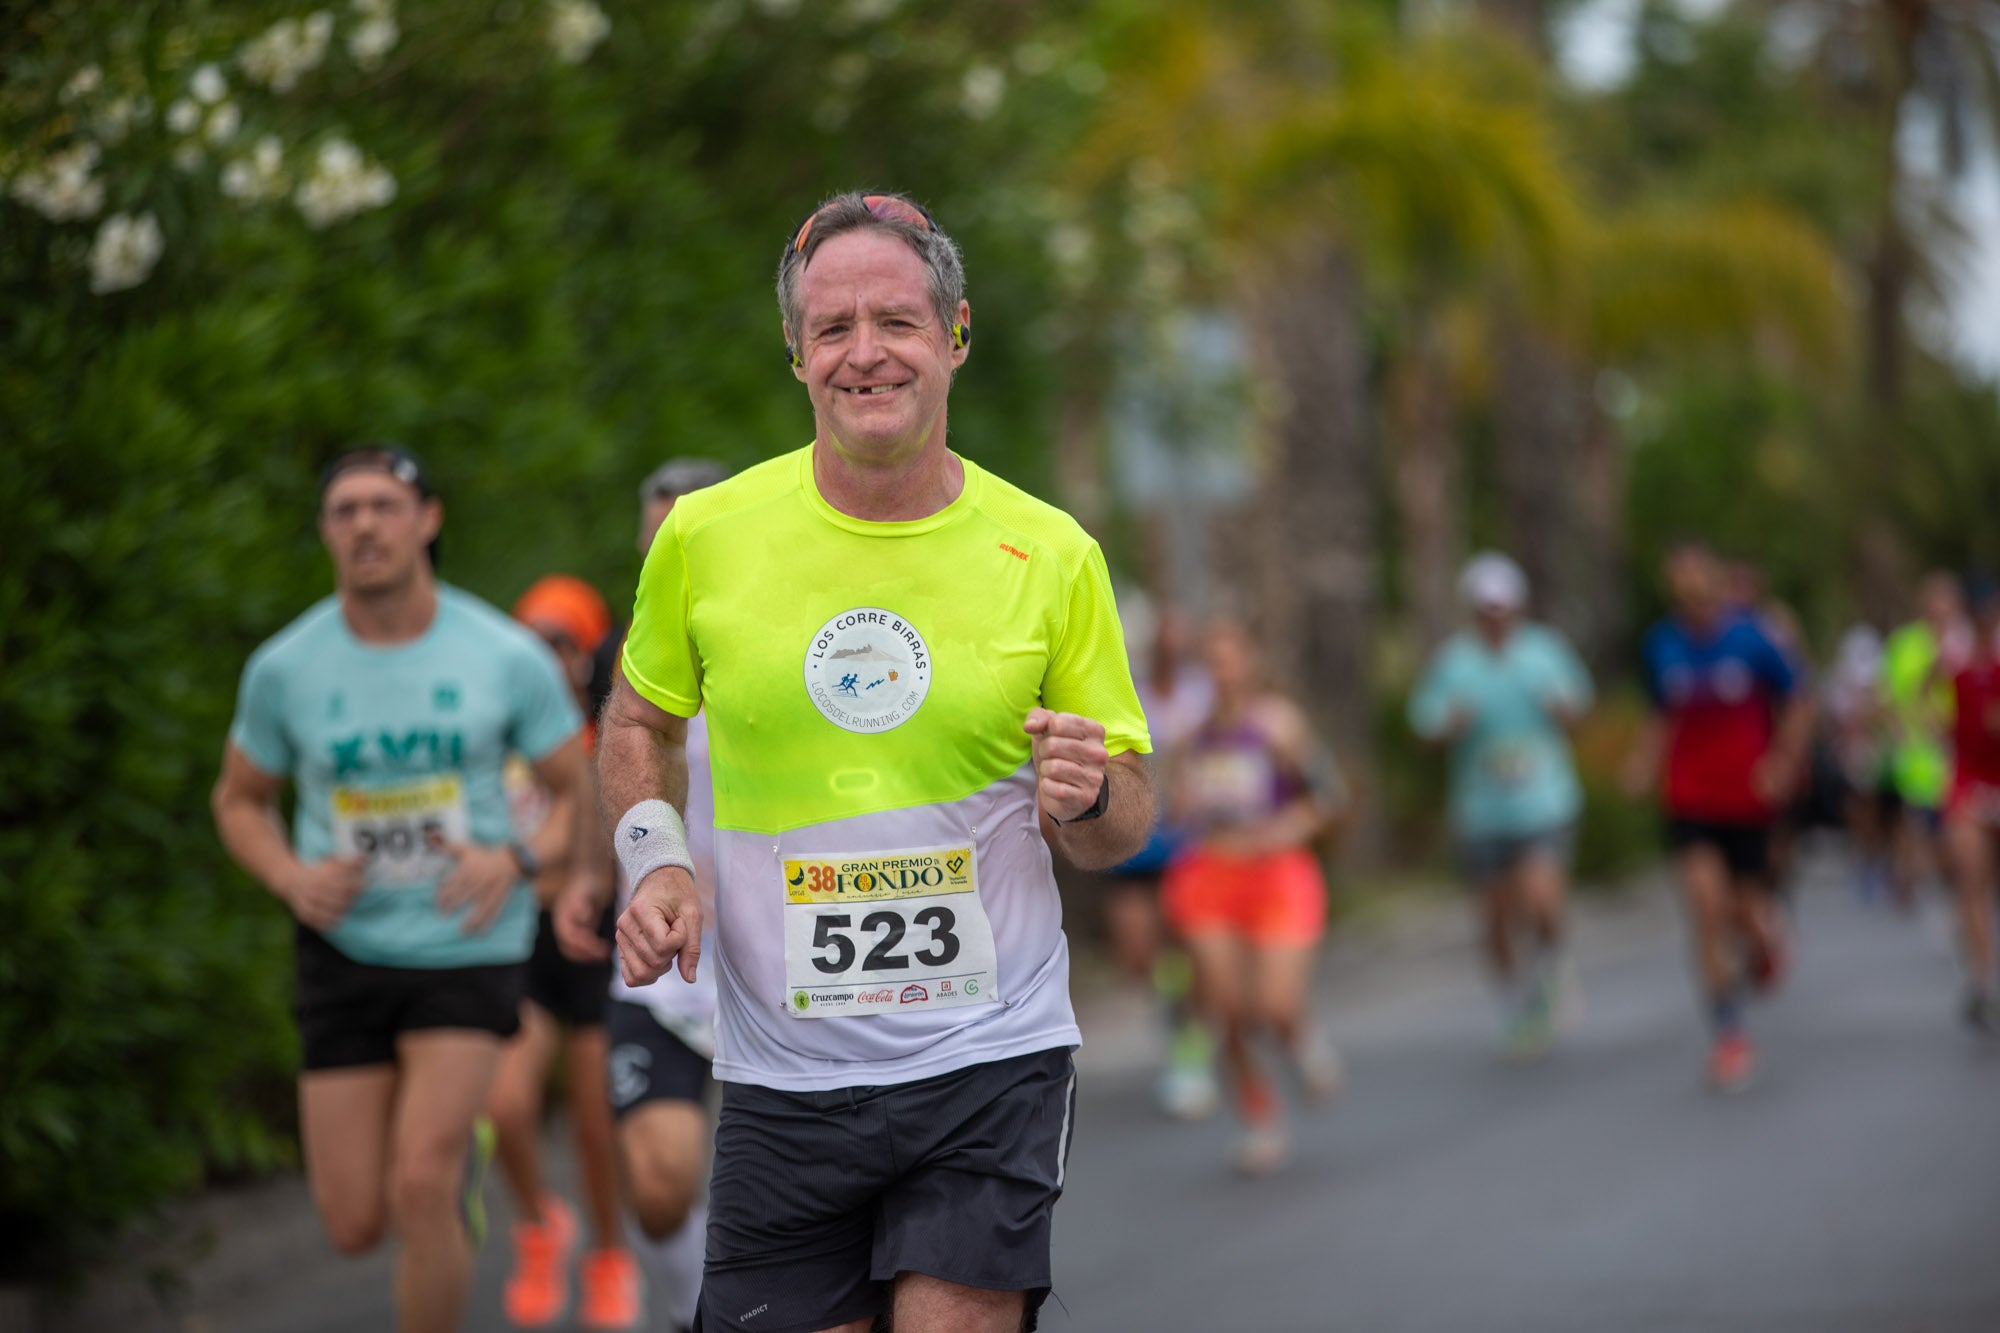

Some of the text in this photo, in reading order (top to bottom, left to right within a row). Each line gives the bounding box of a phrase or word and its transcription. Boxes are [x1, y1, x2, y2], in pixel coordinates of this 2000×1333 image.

[813, 612, 926, 670] LOS CORRE BIRRAS
[811, 681, 920, 728] LOCOSDELRUNNING.COM
[841, 862, 878, 872] GRAN
[882, 857, 933, 869] PREMIO
[807, 865, 836, 892] 38
[837, 866, 943, 893] FONDO
[811, 906, 960, 974] 523
[811, 993, 854, 1002] Cruzcampo
[740, 1303, 768, 1322] EVADICT
